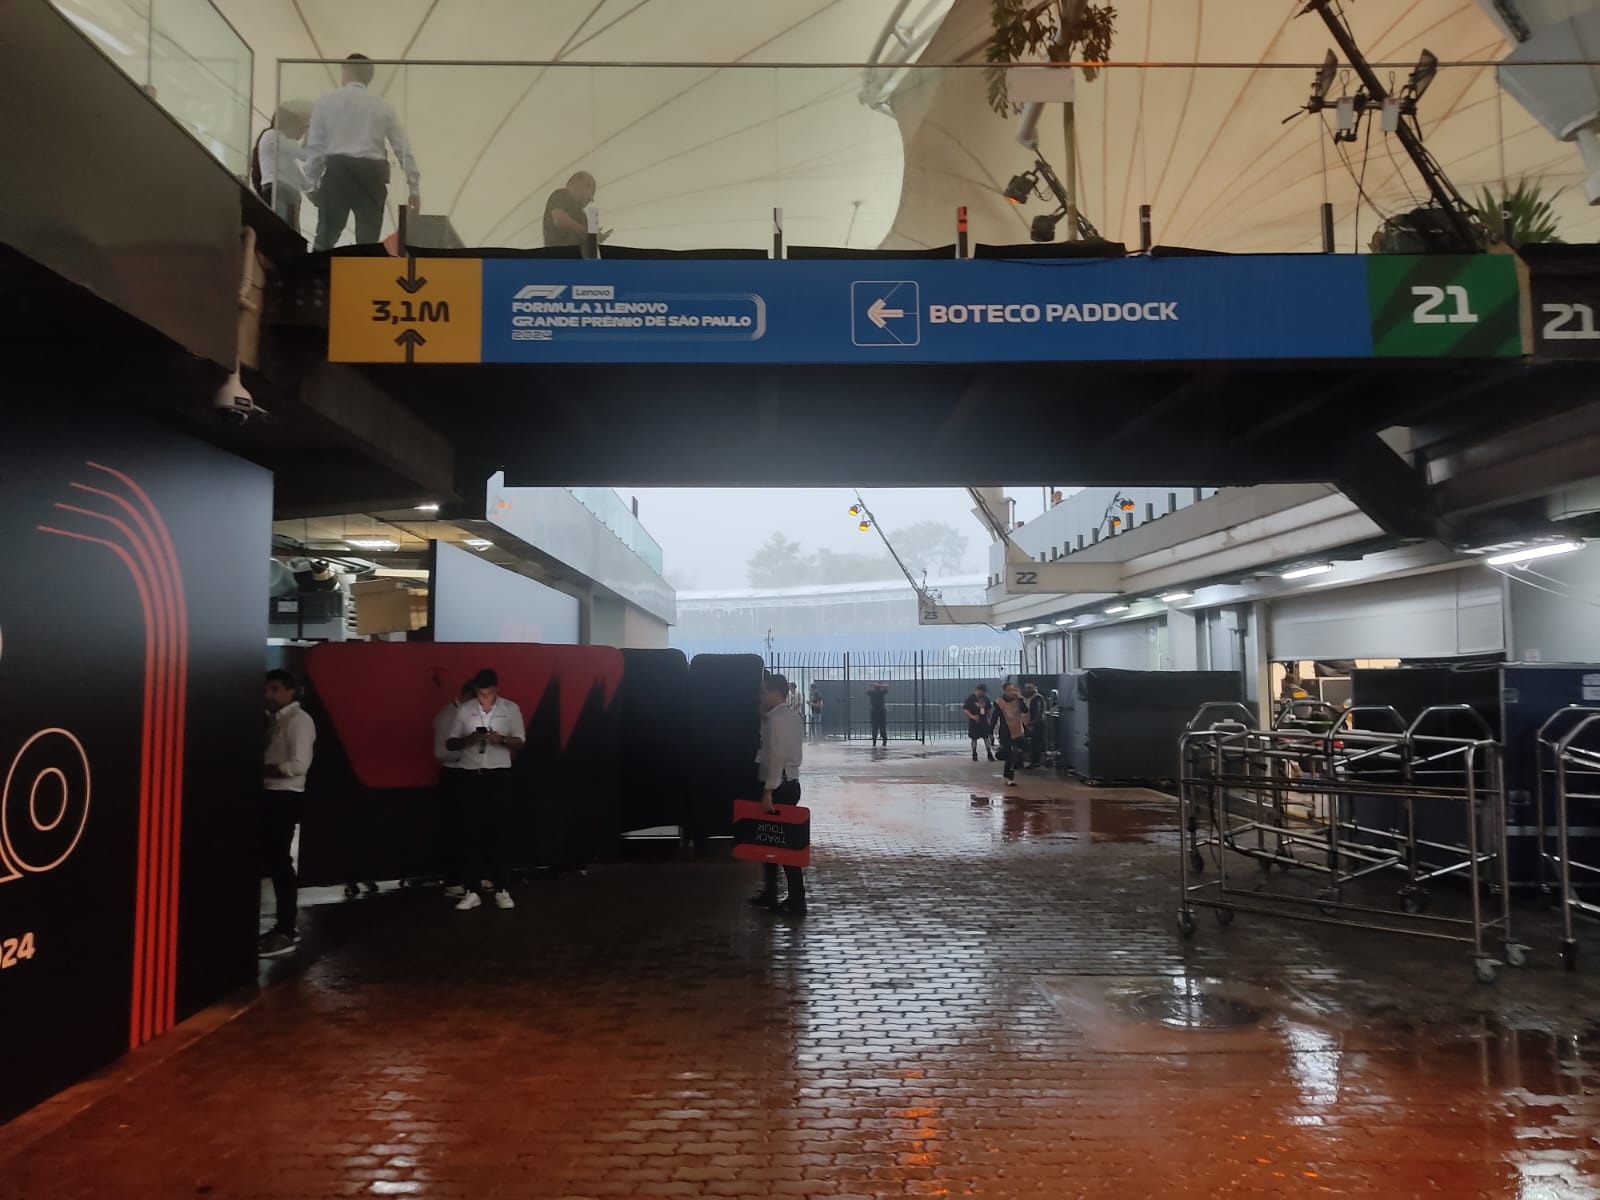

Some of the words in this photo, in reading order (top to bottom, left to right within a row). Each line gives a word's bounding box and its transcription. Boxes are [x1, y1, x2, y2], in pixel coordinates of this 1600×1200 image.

[575, 288, 611, 298] Lenovo
[511, 302, 592, 313] FORMULA
[594, 302, 604, 314] 1
[605, 302, 669, 314] LENOVO
[1410, 285, 1480, 324] 21
[372, 300, 450, 325] 3,1M
[929, 304, 1041, 324] BOTECO
[1046, 302, 1179, 323] PADDOCK
[511, 316, 580, 327] GRANDE
[645, 316, 667, 327] DE
[701, 316, 752, 327] PAULO
[1542, 303, 1600, 340] 21
[1015, 572, 1037, 585] 22
[757, 823, 784, 834] TOUR
[755, 833, 785, 844] TRACK
